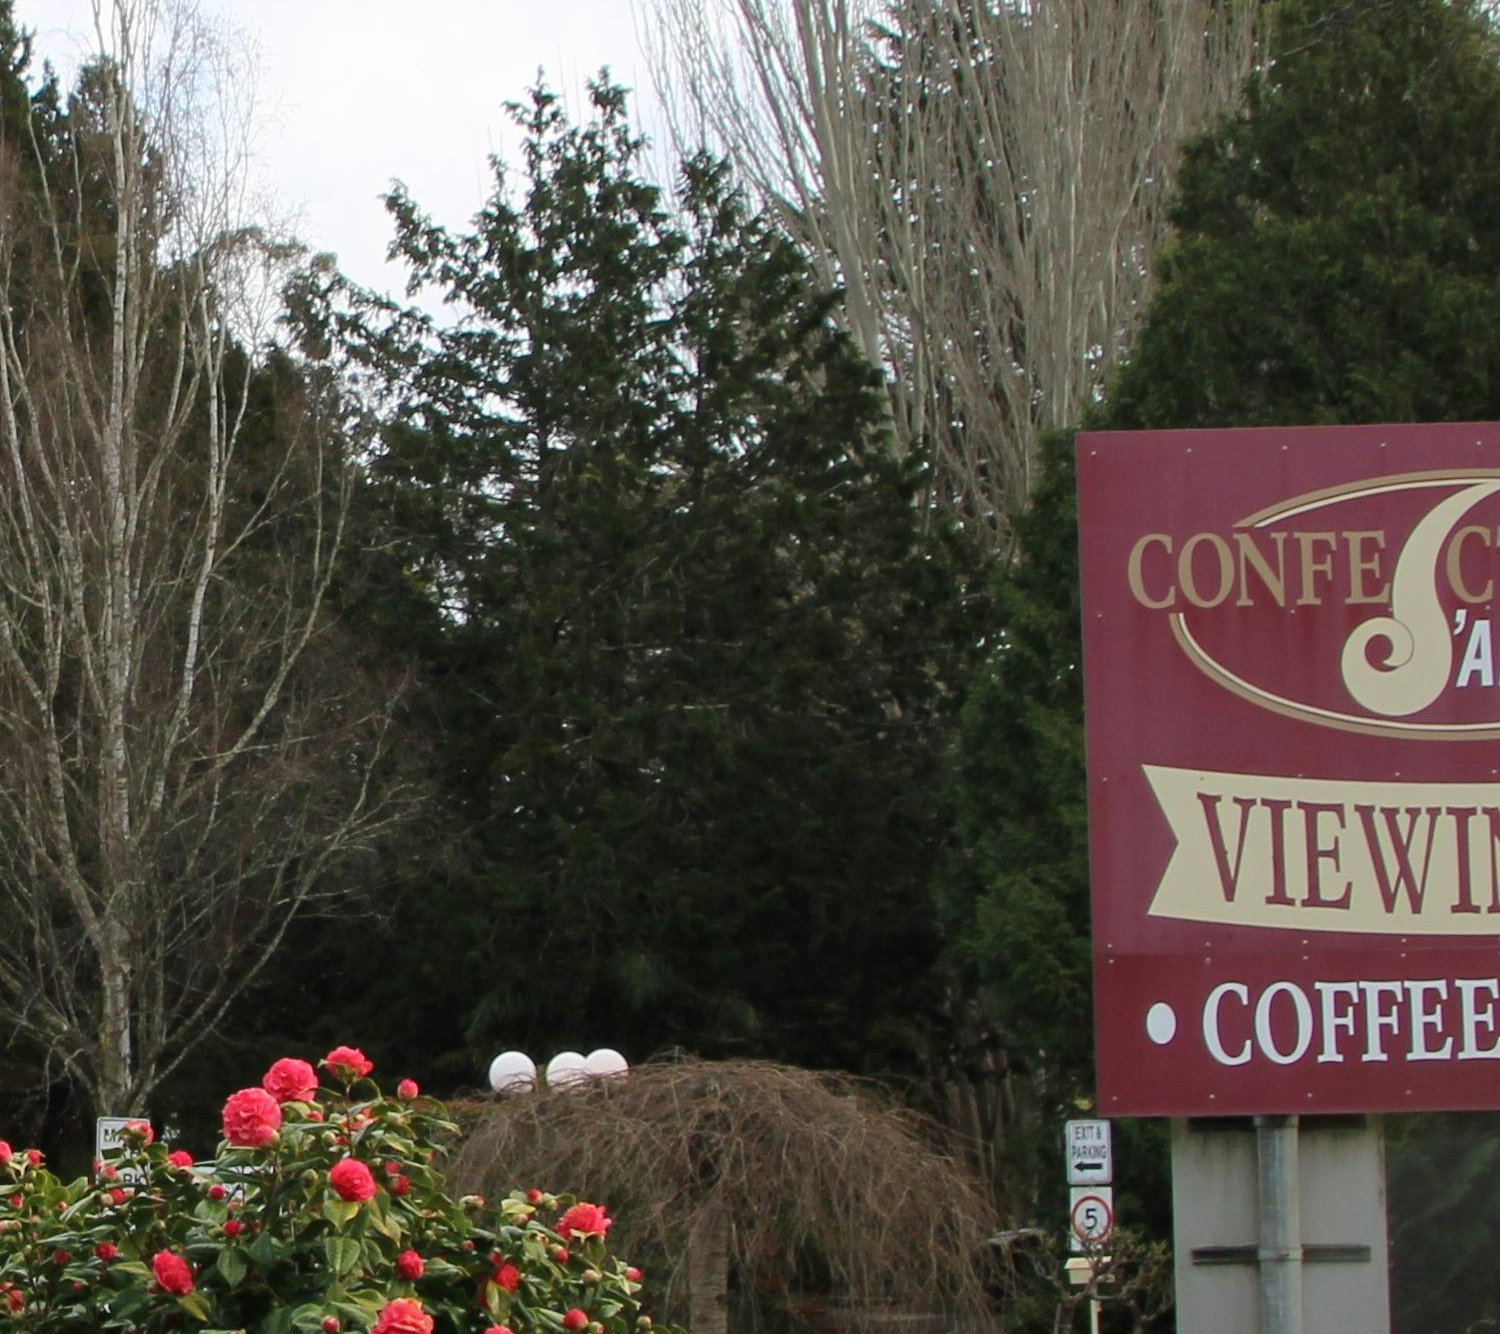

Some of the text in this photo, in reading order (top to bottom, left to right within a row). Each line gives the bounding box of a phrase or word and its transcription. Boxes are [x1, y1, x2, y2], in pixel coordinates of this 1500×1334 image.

[1075, 1126, 1095, 1141] EXIT
[1072, 1144, 1107, 1159] PARKING
[1085, 1208, 1098, 1228] 5
